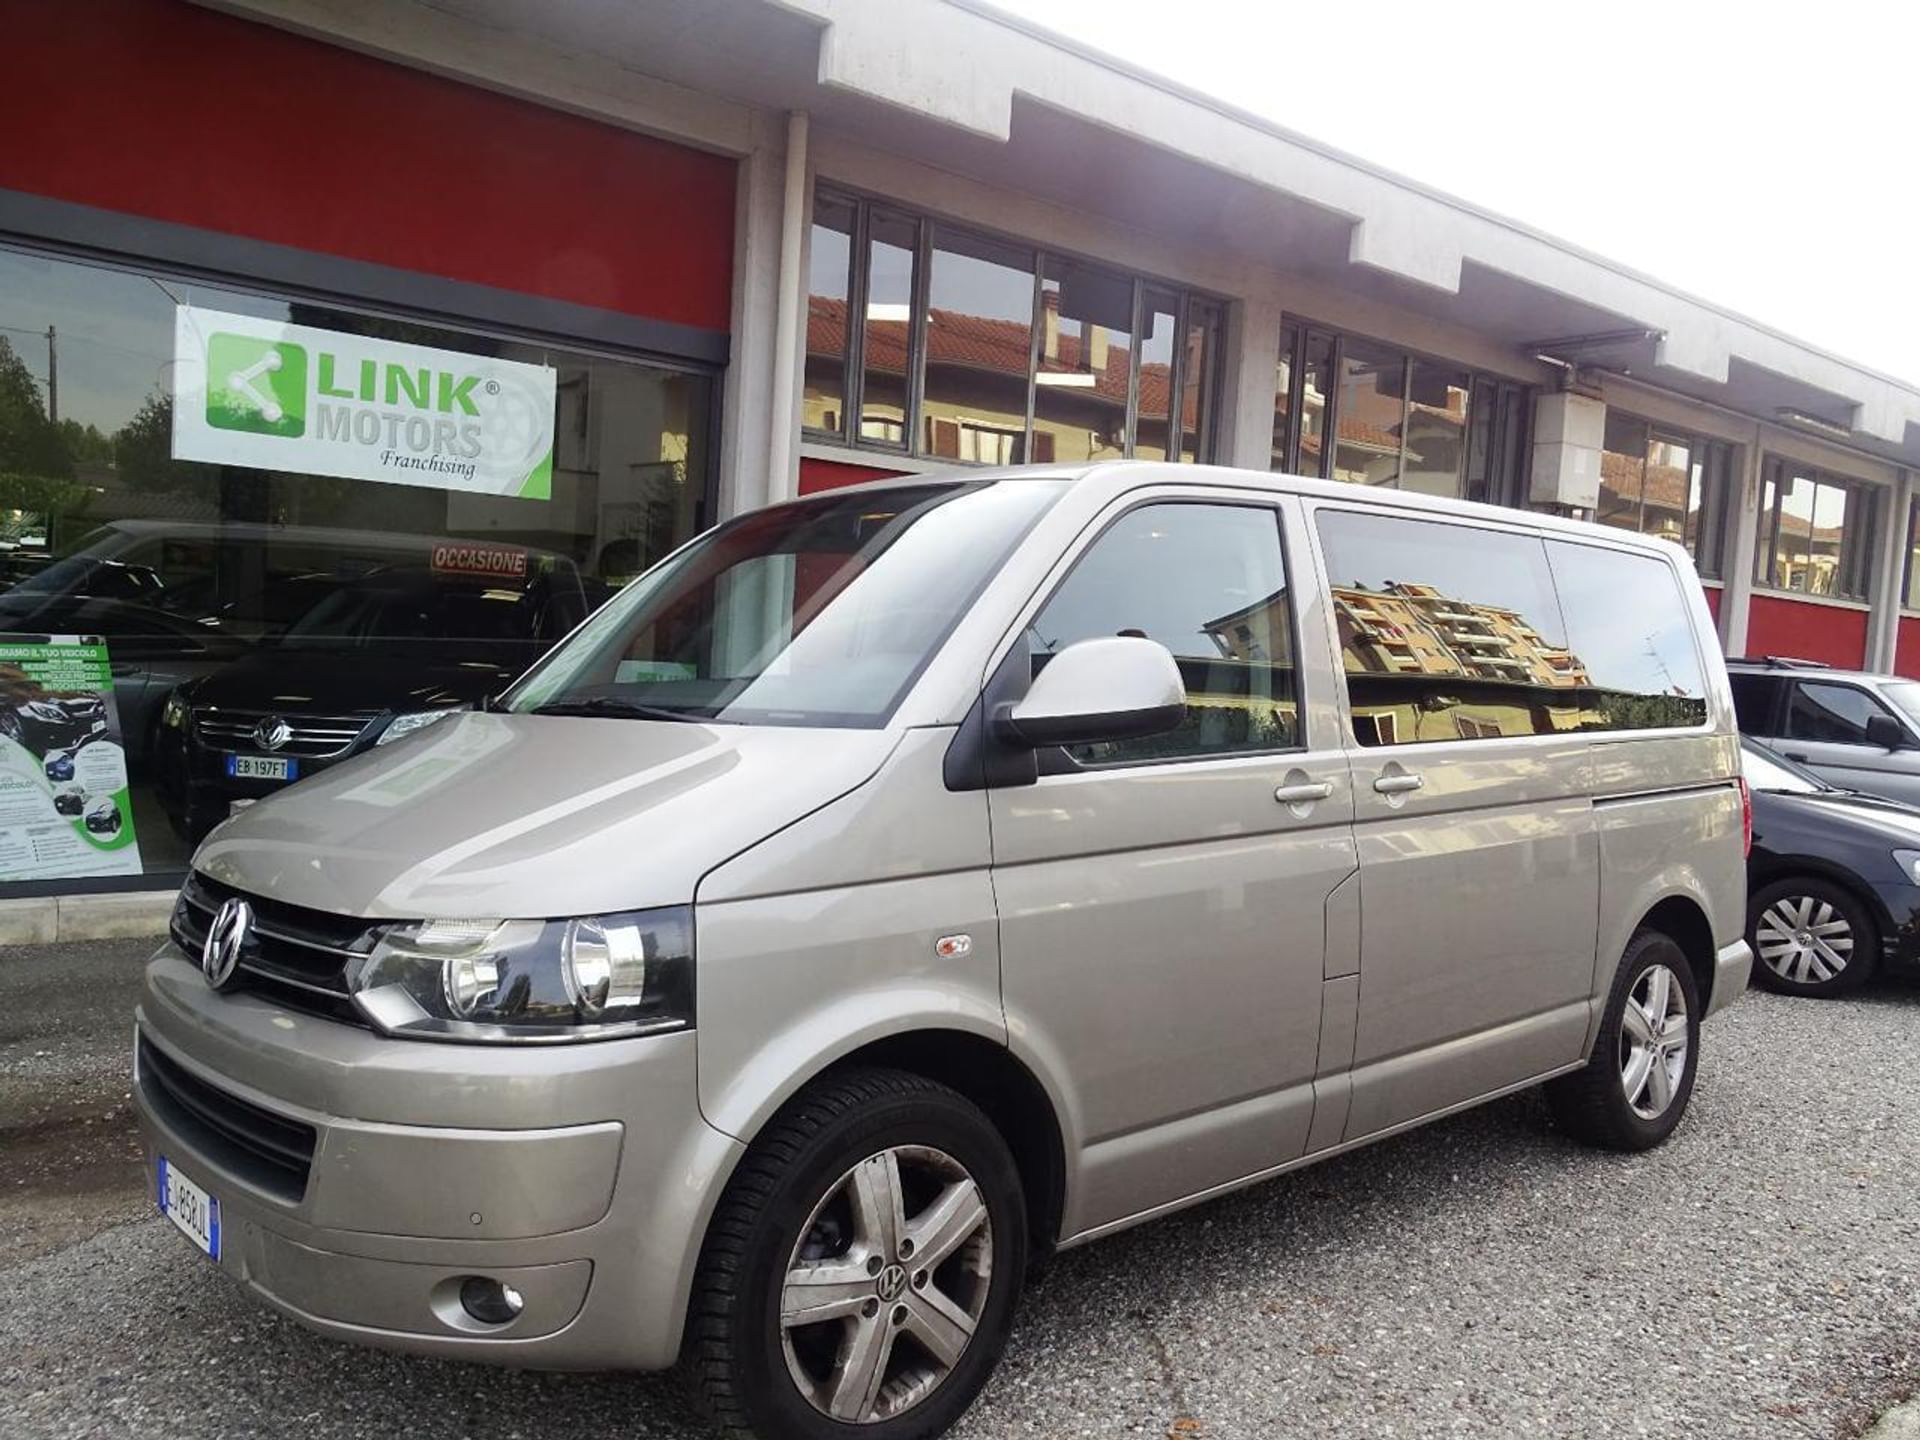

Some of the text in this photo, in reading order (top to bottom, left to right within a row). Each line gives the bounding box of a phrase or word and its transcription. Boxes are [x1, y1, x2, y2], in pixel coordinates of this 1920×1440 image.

[318, 353, 481, 416] LINK
[316, 403, 482, 458] MOTORS
[380, 450, 477, 482] Franchising
[435, 547, 526, 573] OCCASIONE
[41, 648, 60, 658] TUO
[61, 649, 97, 658] VEICOLO
[237, 760, 250, 774] EB
[254, 761, 287, 777] 197FT
